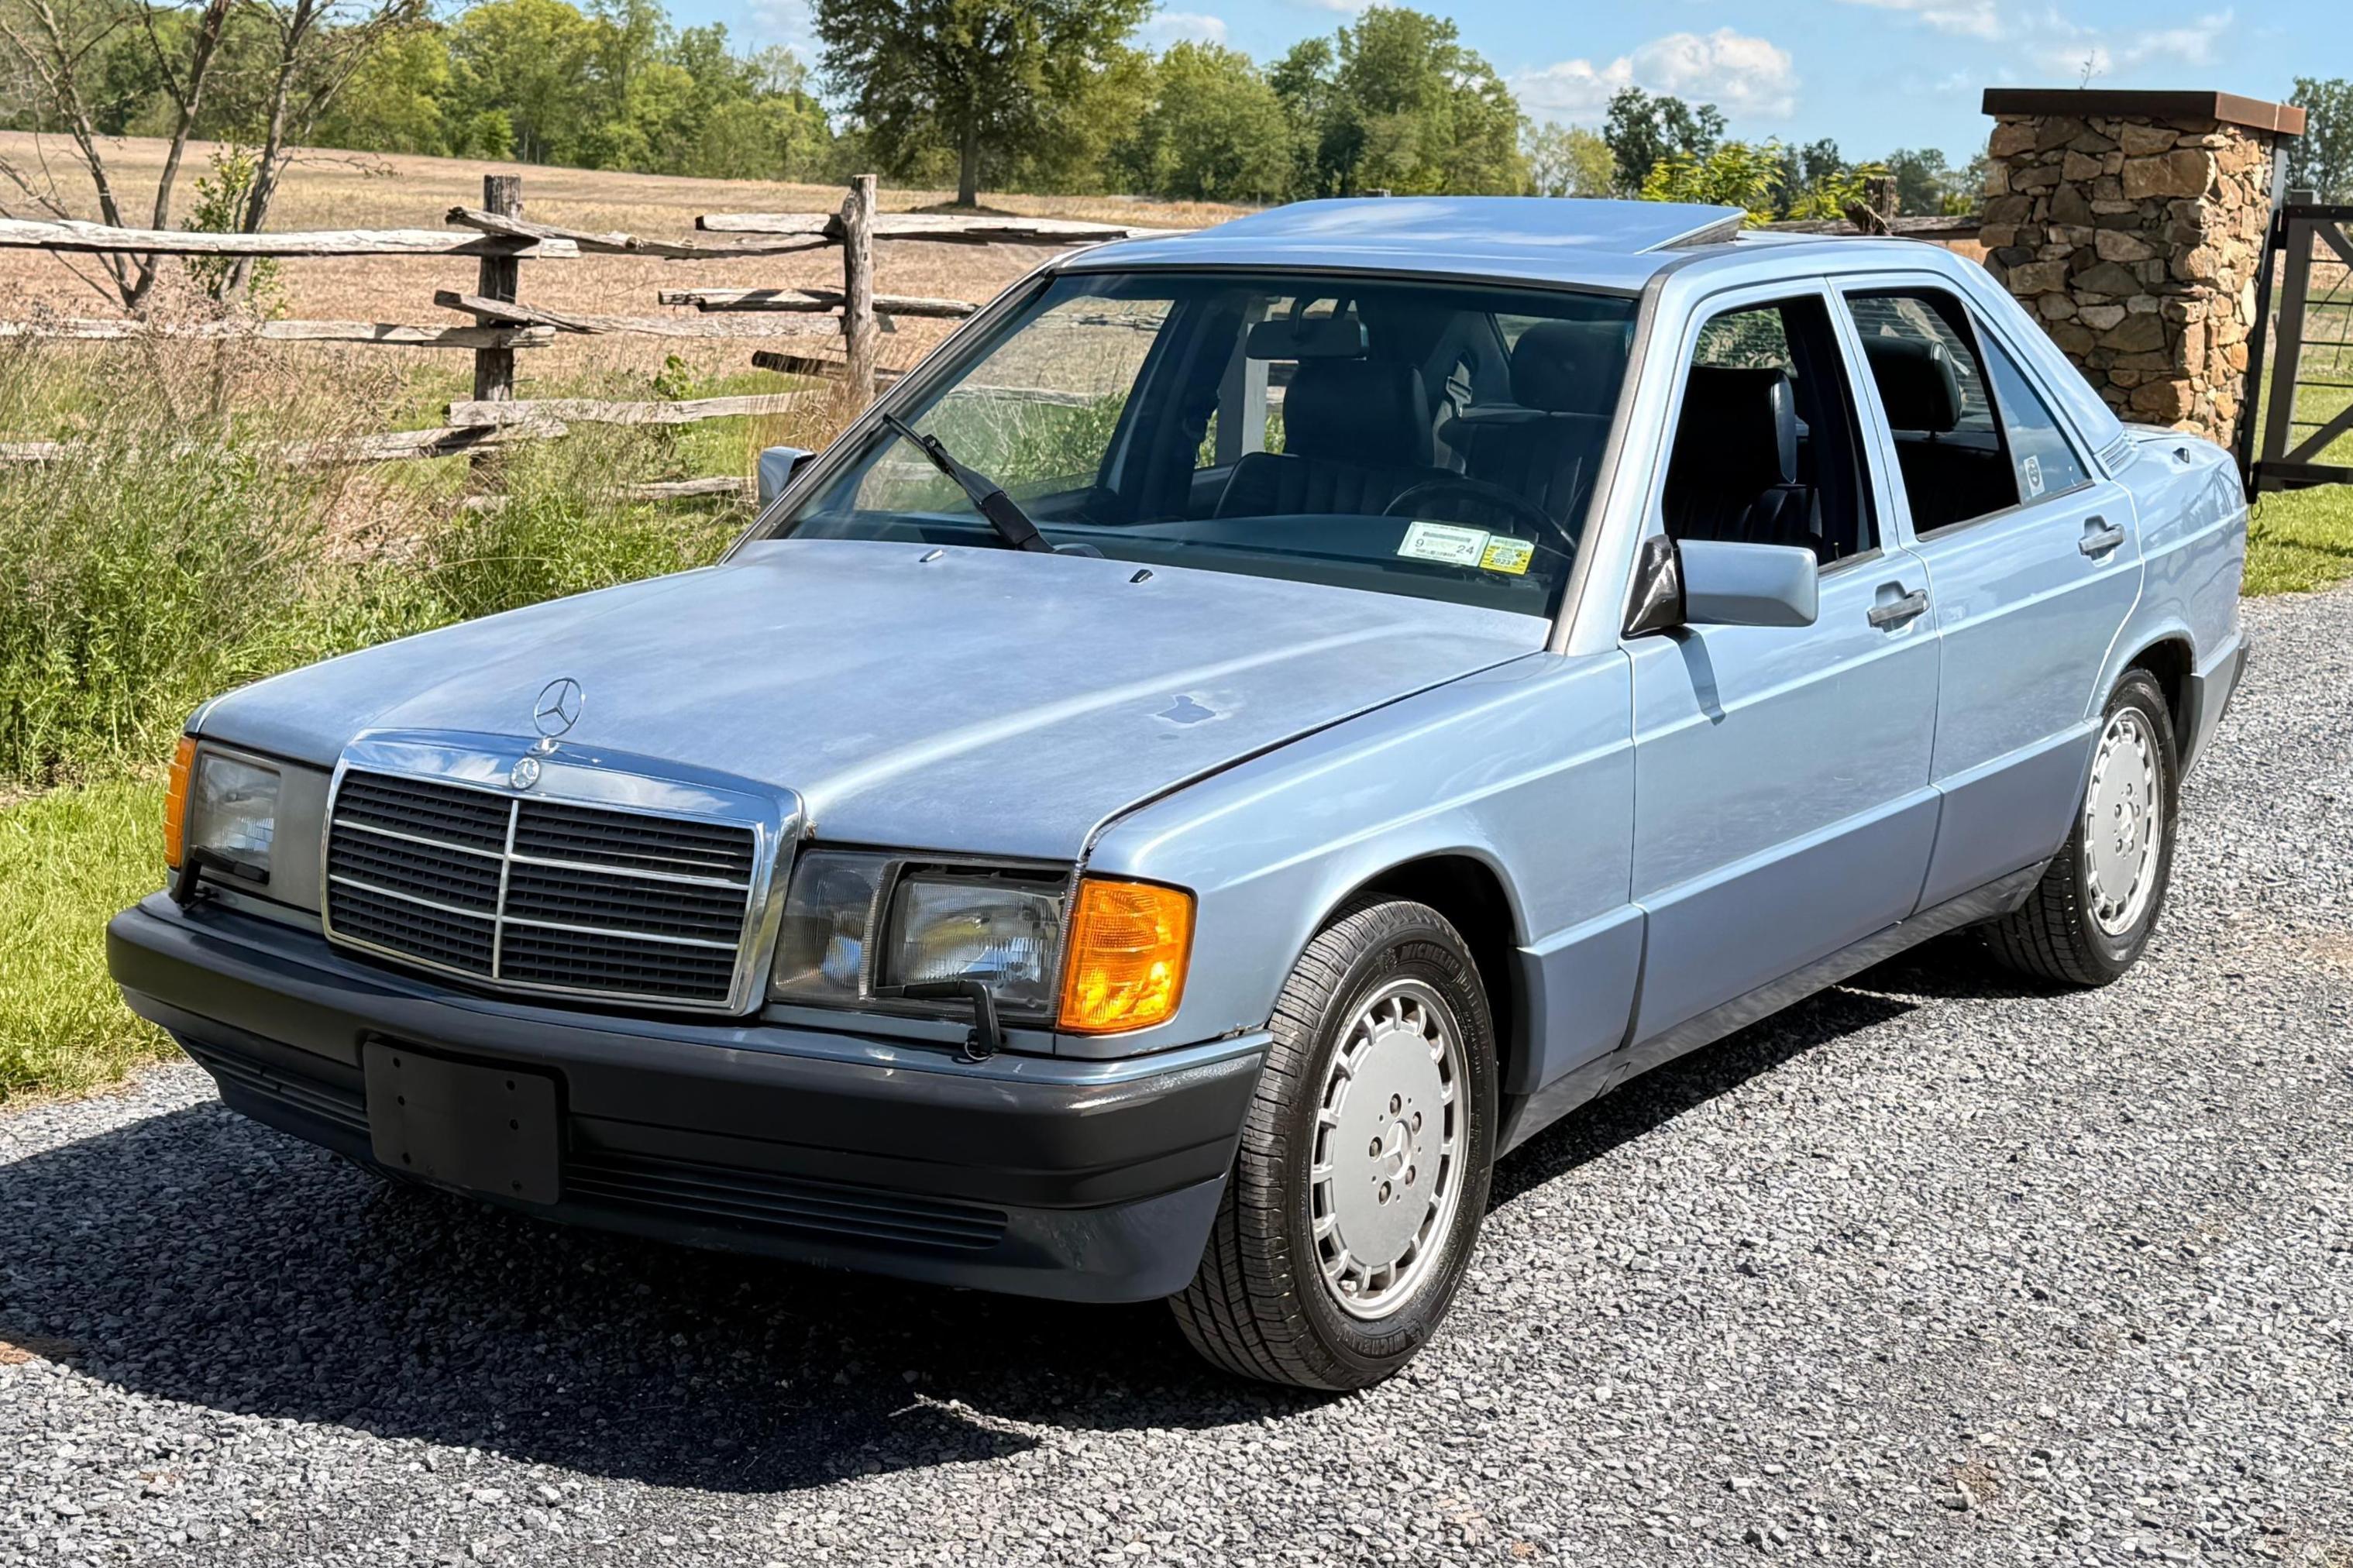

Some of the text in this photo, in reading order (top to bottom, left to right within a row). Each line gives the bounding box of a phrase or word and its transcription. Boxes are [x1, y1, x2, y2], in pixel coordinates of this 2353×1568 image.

[1415, 538, 1424, 548] 9
[1456, 545, 1474, 555] 24
[1491, 557, 1512, 566] 2023
[1401, 943, 1459, 977] MICHELIN
[1343, 1329, 1406, 1355] MICHELIN
